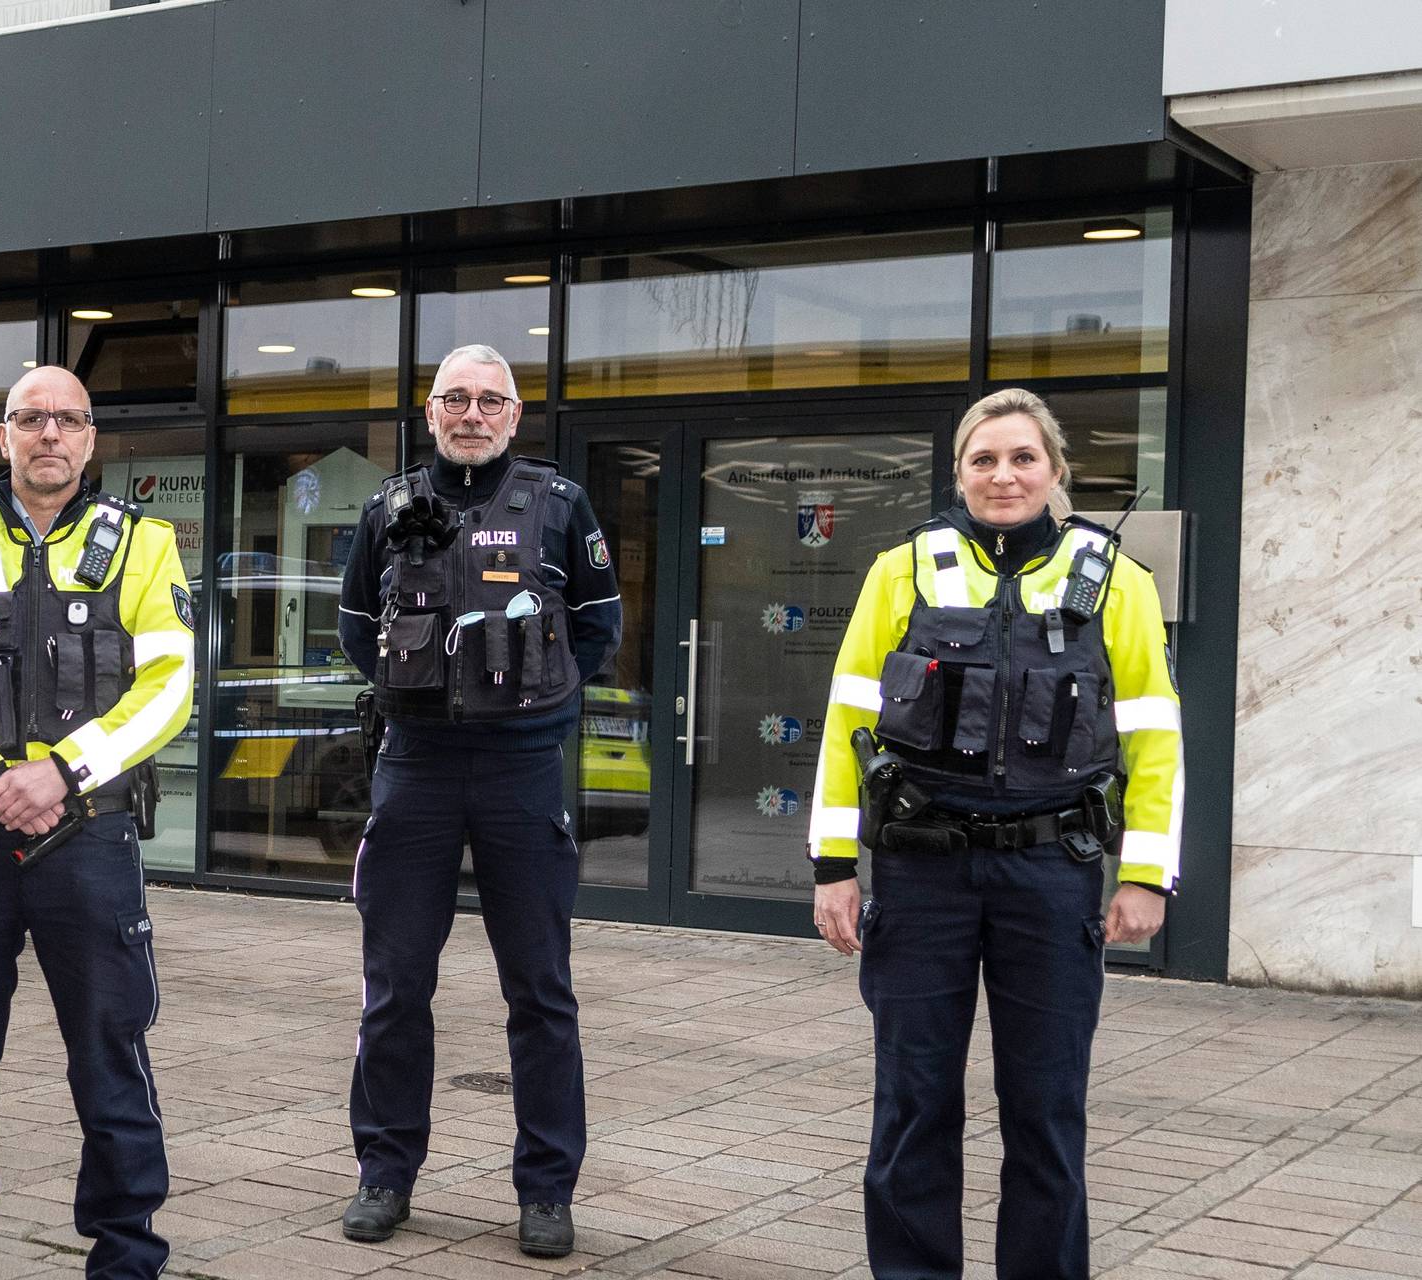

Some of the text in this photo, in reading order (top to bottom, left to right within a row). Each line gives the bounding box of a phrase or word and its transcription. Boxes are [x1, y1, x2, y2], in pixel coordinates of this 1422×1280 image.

[728, 467, 911, 484] Anlaufstelle Marktstraße
[471, 530, 517, 546] POLIZEI
